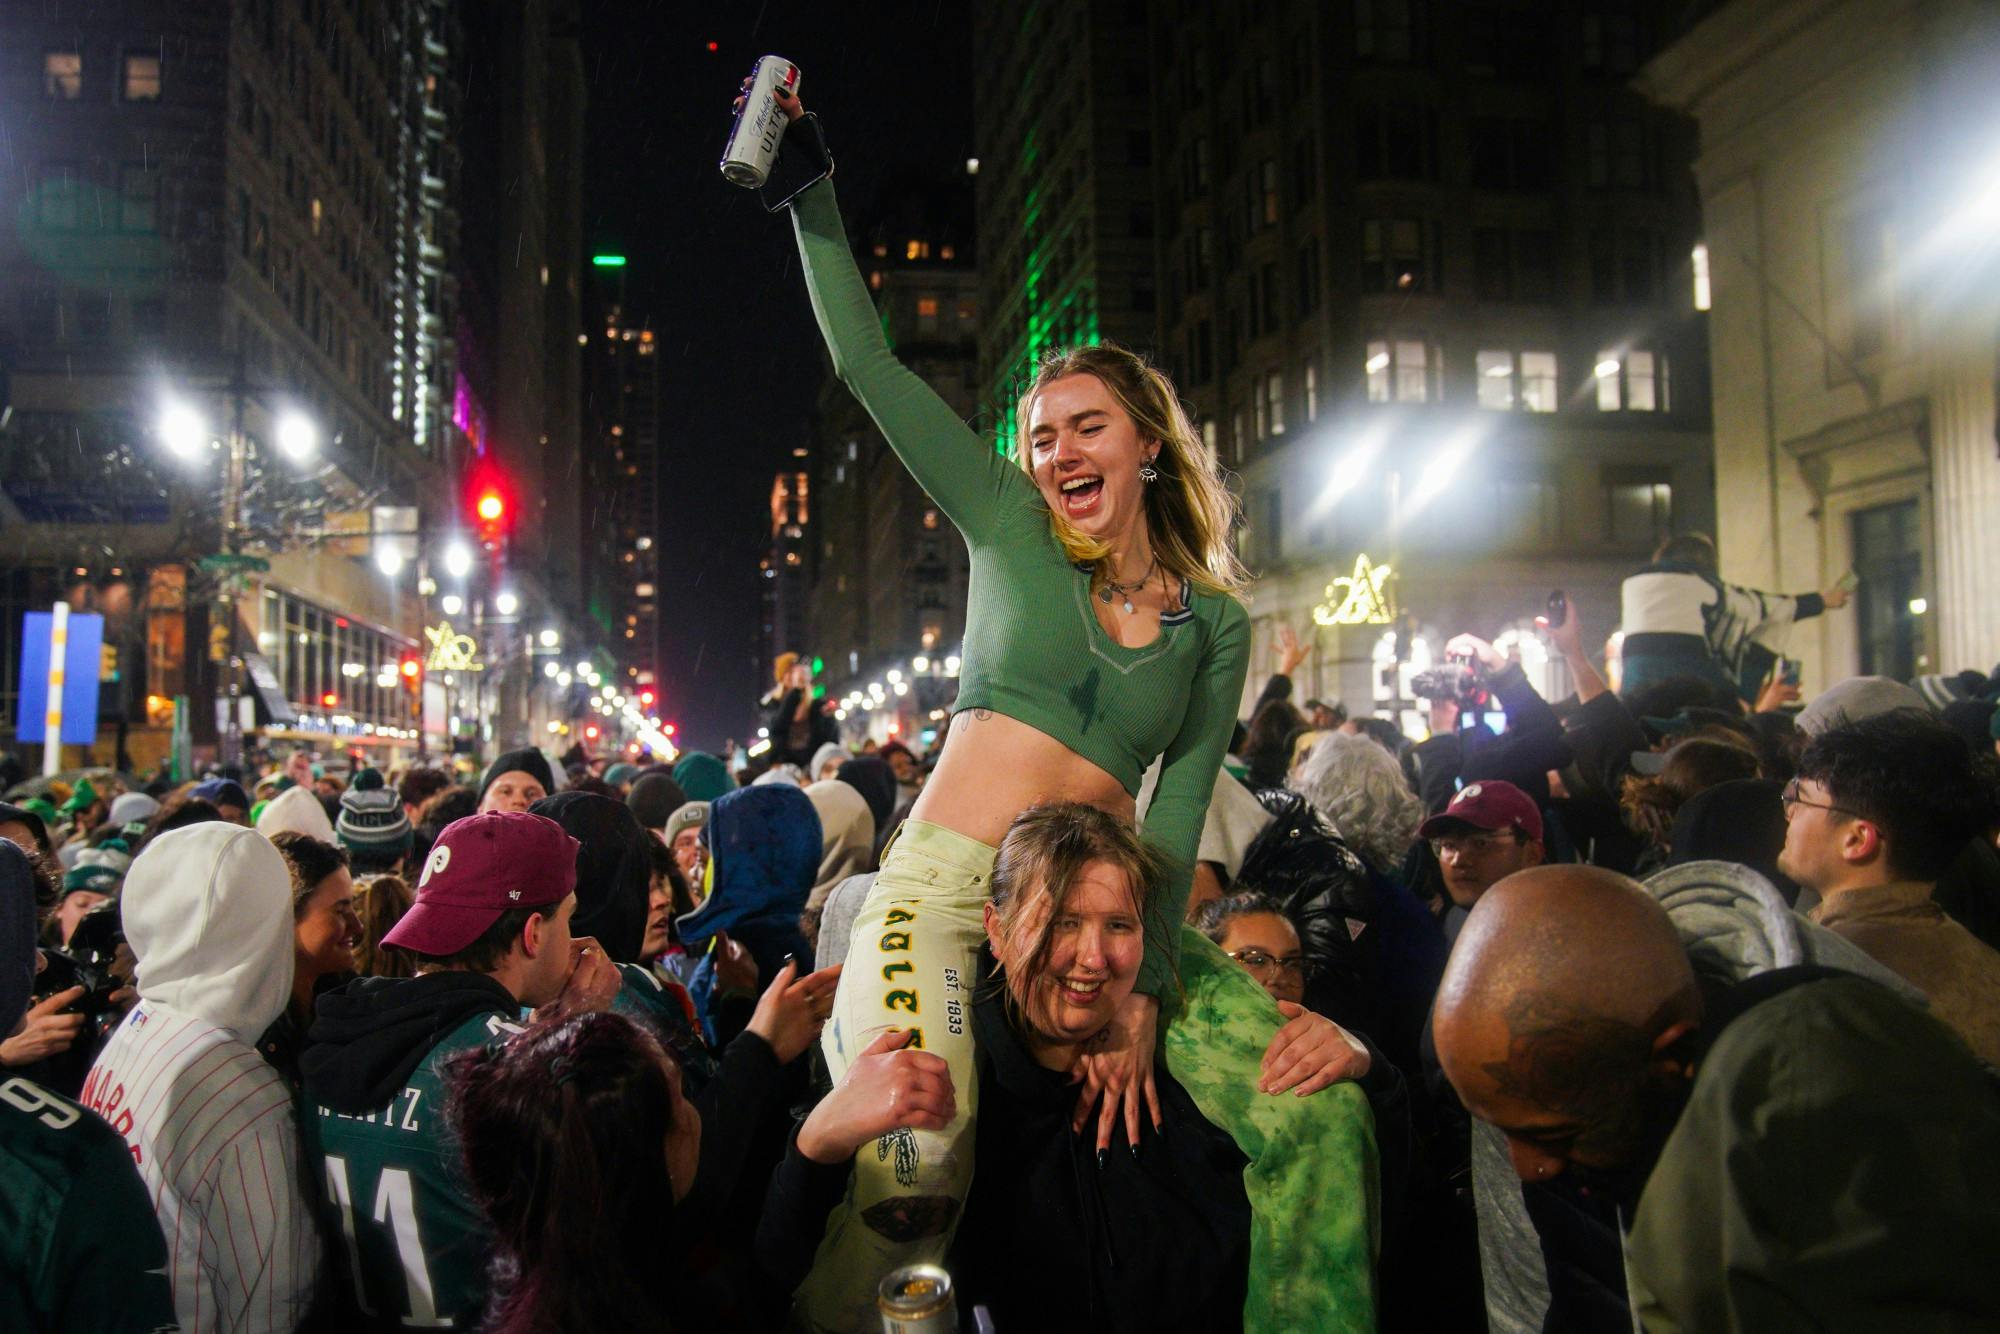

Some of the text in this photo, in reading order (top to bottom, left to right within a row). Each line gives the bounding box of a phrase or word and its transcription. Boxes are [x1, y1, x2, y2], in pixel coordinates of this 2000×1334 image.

[761, 104, 784, 153] ULTR
[945, 968, 963, 1035] EST. 1933
